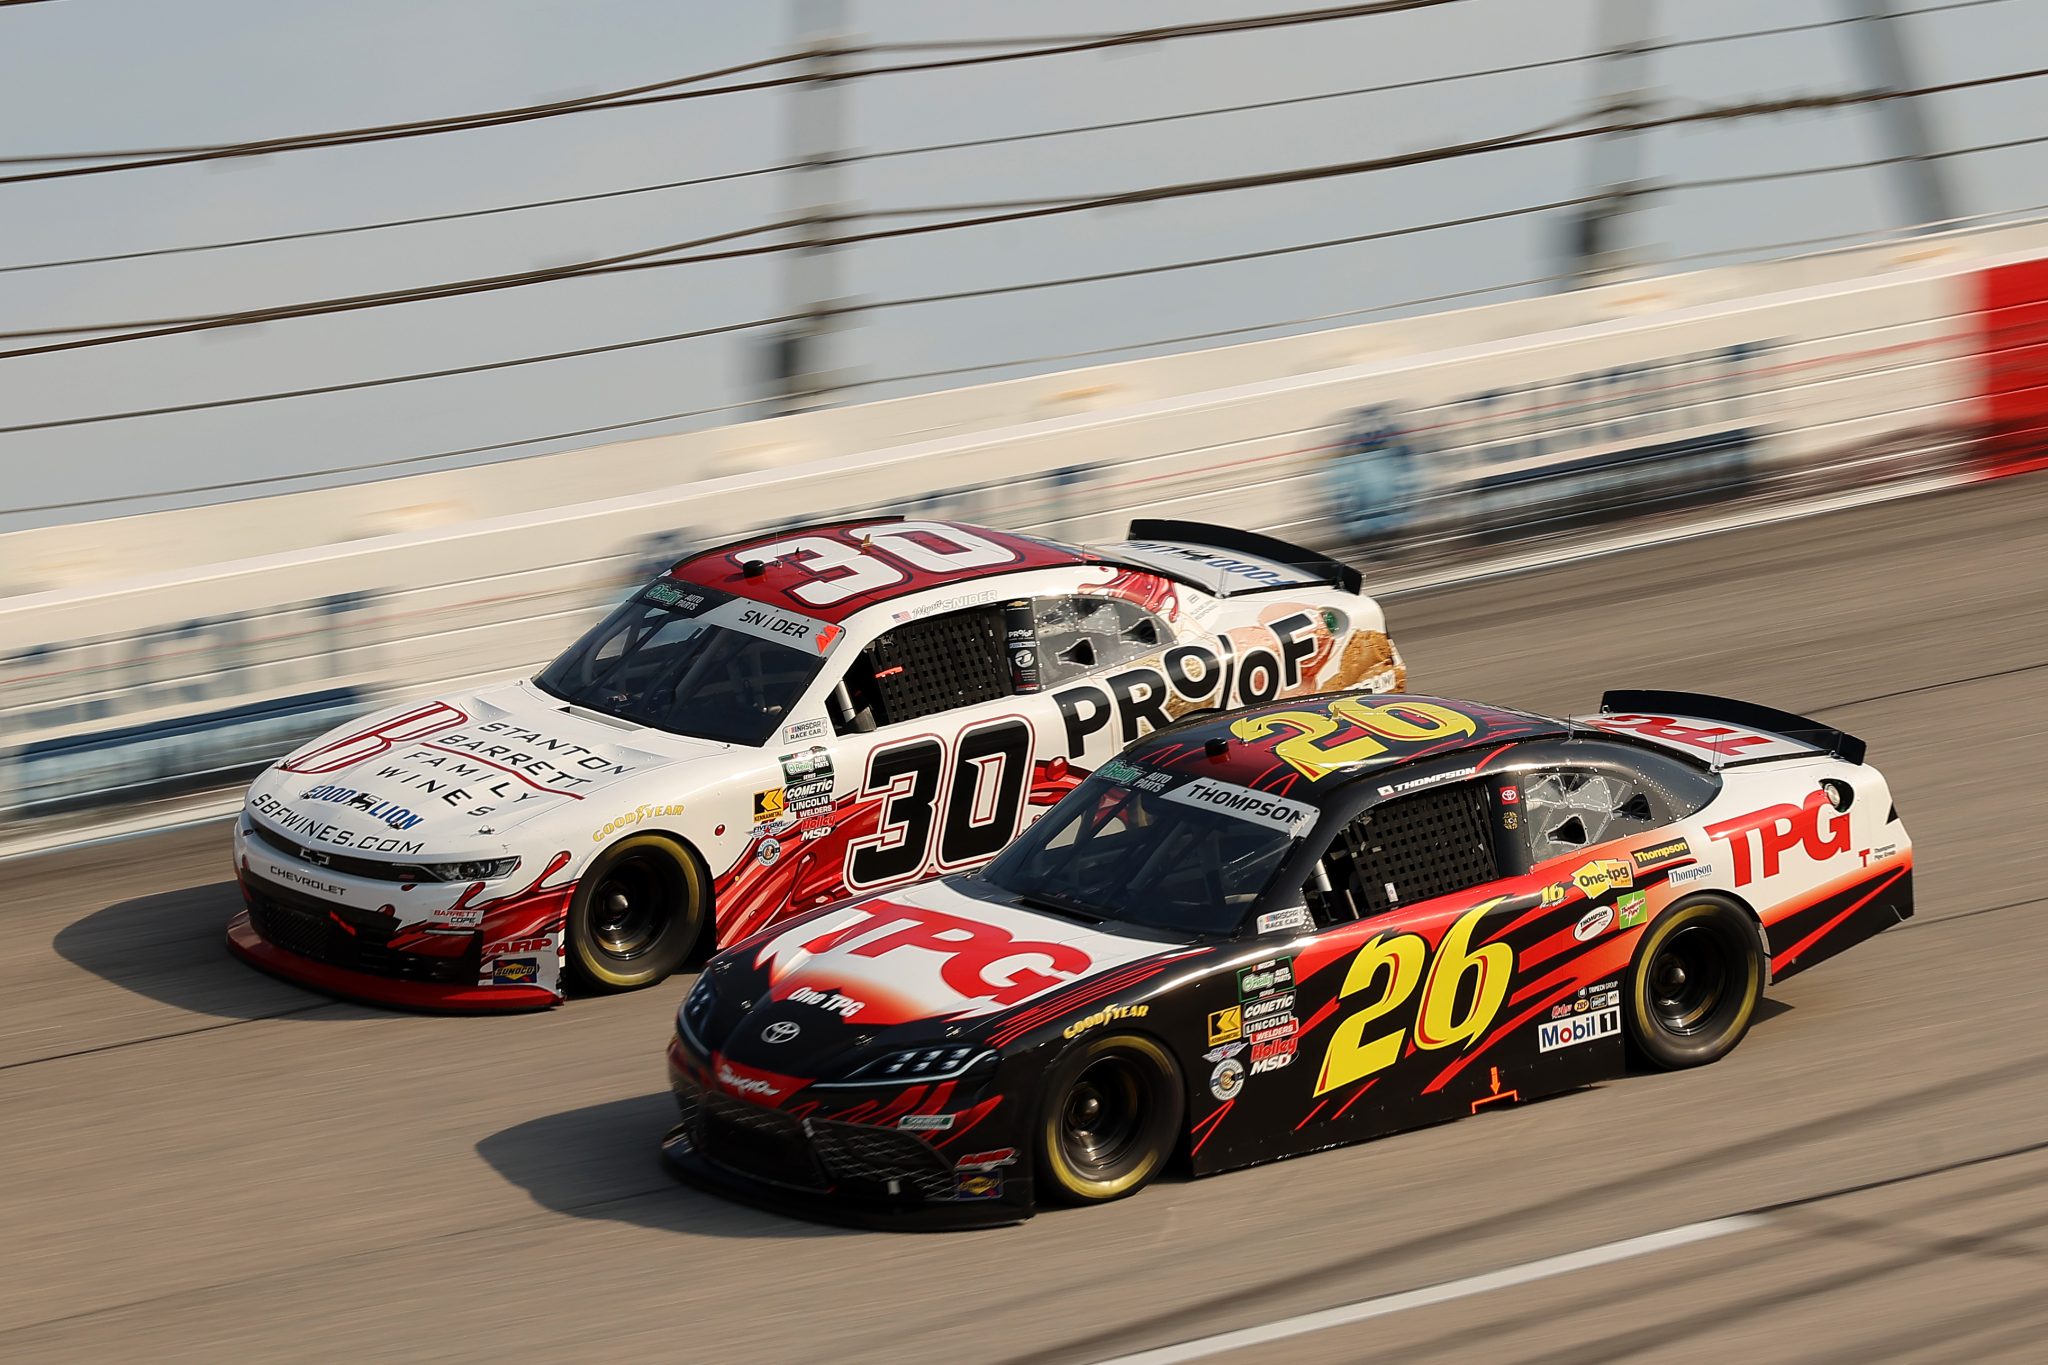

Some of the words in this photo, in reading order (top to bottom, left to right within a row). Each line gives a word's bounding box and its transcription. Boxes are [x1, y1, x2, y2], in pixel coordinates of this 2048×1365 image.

[732, 521, 1017, 605] 30
[675, 600, 698, 611] PARTS
[942, 590, 998, 611] SNIDER
[738, 609, 810, 639] SNIDER
[790, 732, 807, 740] RACE
[808, 728, 822, 737] CAR
[1230, 694, 1477, 783] 26
[437, 734, 592, 788] BARRETT
[479, 722, 636, 775] STANTON
[402, 750, 540, 803] FAMILY
[1133, 778, 1165, 793] PARTS
[1145, 772, 1173, 784] AUTO
[1394, 766, 1477, 792] THOMPSON
[376, 765, 496, 817] WINES
[786, 779, 834, 800] COMETIC
[309, 784, 357, 803] FOOD
[367, 801, 424, 831] LION
[791, 795, 829, 812] LINCOLN
[799, 805, 833, 818] WELDERS
[846, 714, 1035, 892] 30
[1189, 784, 1306, 824] THOMPSON
[252, 793, 424, 855] SBFWINES.COM
[592, 803, 685, 843] GOODYEAR
[801, 815, 836, 831] Holley
[801, 827, 832, 842] MSD
[1703, 788, 1851, 888] TPG
[1634, 841, 1688, 863] Thompson
[270, 866, 347, 897] CHEVROLET
[1669, 863, 1713, 884] Thompson
[1540, 881, 1566, 904] 16
[449, 916, 476, 924] COPE
[1264, 919, 1284, 930] RACE
[1284, 917, 1300, 926] CAR
[1580, 909, 1609, 927] THOMPSON
[487, 938, 553, 954] ARP
[799, 898, 1092, 1006] TPG
[493, 966, 536, 976] SUNOCO
[787, 986, 824, 1005] One
[819, 993, 866, 1018] TPG
[1244, 994, 1294, 1019] COMETIC
[1312, 896, 1514, 1098] 26
[1062, 1003, 1150, 1039] GOODYEAR
[1246, 1014, 1290, 1034] LINCOLN
[1256, 1024, 1295, 1041] WELDERS
[1541, 1015, 1596, 1049] Mobil
[1251, 1037, 1299, 1063] Holley
[1250, 1054, 1293, 1077] MSD
